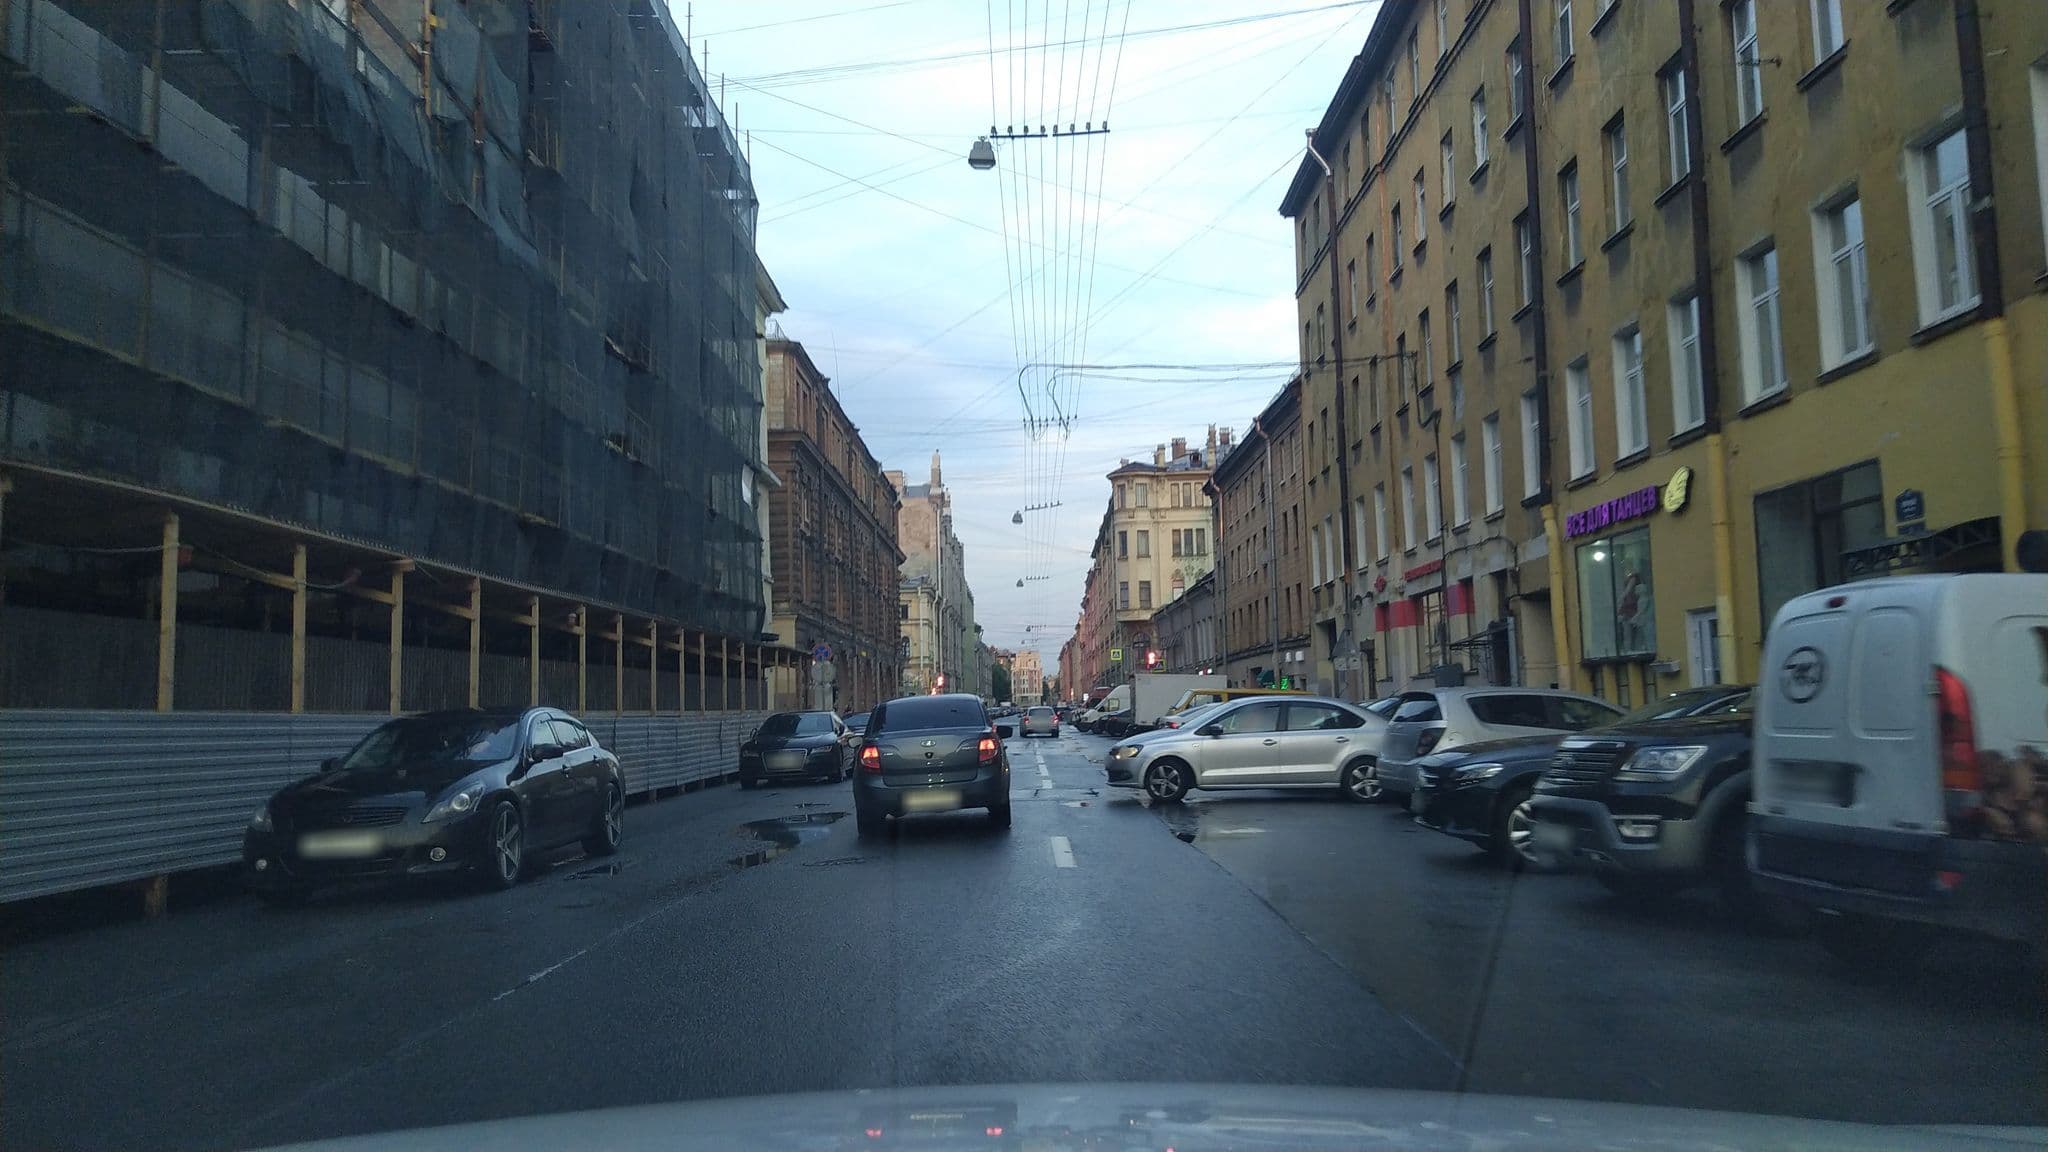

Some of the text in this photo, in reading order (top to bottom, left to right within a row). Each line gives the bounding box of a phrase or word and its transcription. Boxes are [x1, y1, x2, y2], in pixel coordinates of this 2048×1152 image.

[1567, 485, 1657, 537] ВСЕ ДЛЯ ТАНЦЕВ
